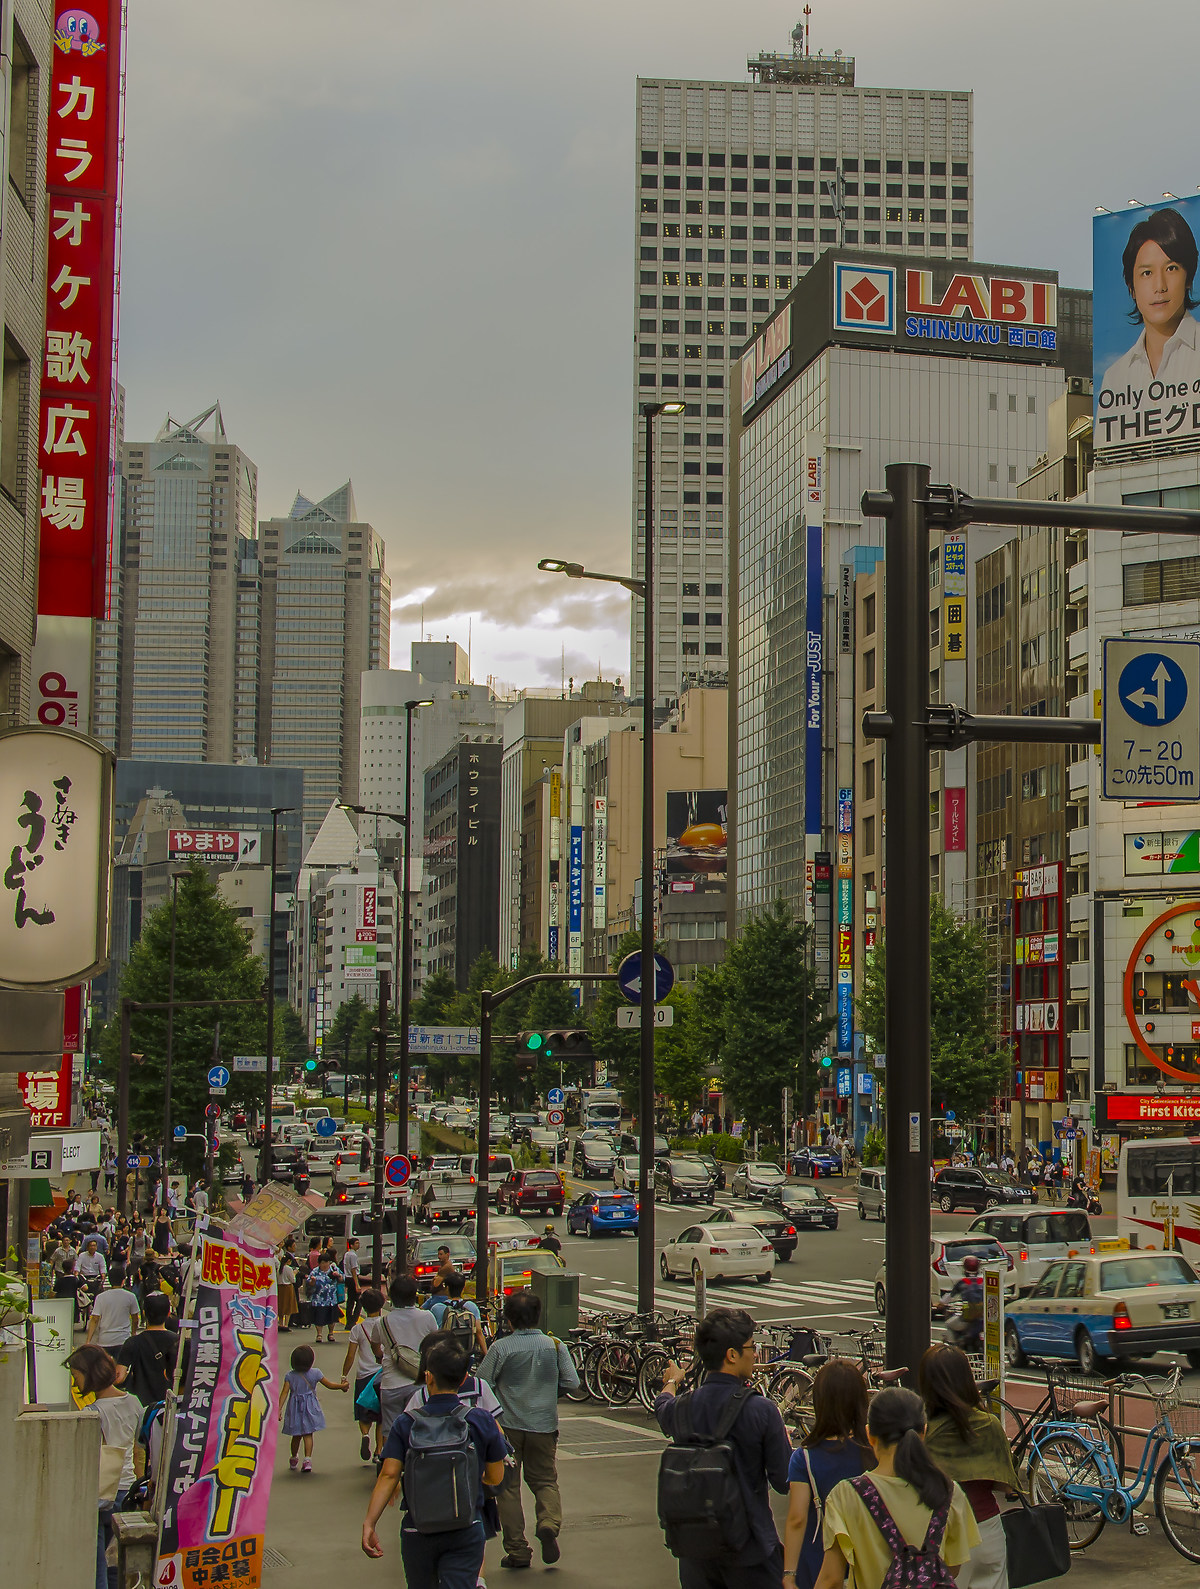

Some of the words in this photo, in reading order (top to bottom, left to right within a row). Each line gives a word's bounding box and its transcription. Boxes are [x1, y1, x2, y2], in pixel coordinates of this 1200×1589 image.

[42, 76, 95, 530] カラオケ歌広場
[906, 270, 1057, 326] LABI
[756, 303, 791, 379] LABI
[906, 317, 1000, 344] SHINJUKU
[1007, 327, 1056, 350] 西口館
[1099, 384, 1143, 410] Only
[1148, 379, 1188, 400] One
[808, 458, 817, 488] LABI
[807, 632, 821, 672] JUST
[808, 681, 821, 705] Your
[808, 706, 820, 728] For
[1112, 765, 1194, 786] この先50m
[467, 754, 479, 847] ホウライビル
[840, 791, 852, 800] 6F
[951, 799, 960, 843] ワールドメイト
[174, 832, 235, 851] やまや
[1147, 838, 1179, 847] 新生銀行
[4, 790, 56, 929] うどん
[1031, 871, 1042, 886] BAR
[365, 891, 374, 924] クリナップ
[840, 933, 851, 963] トレカ
[1172, 945, 1193, 954] First
[408, 1033, 477, 1045] 西新宿1丁目
[1140, 1106, 1170, 1117] First
